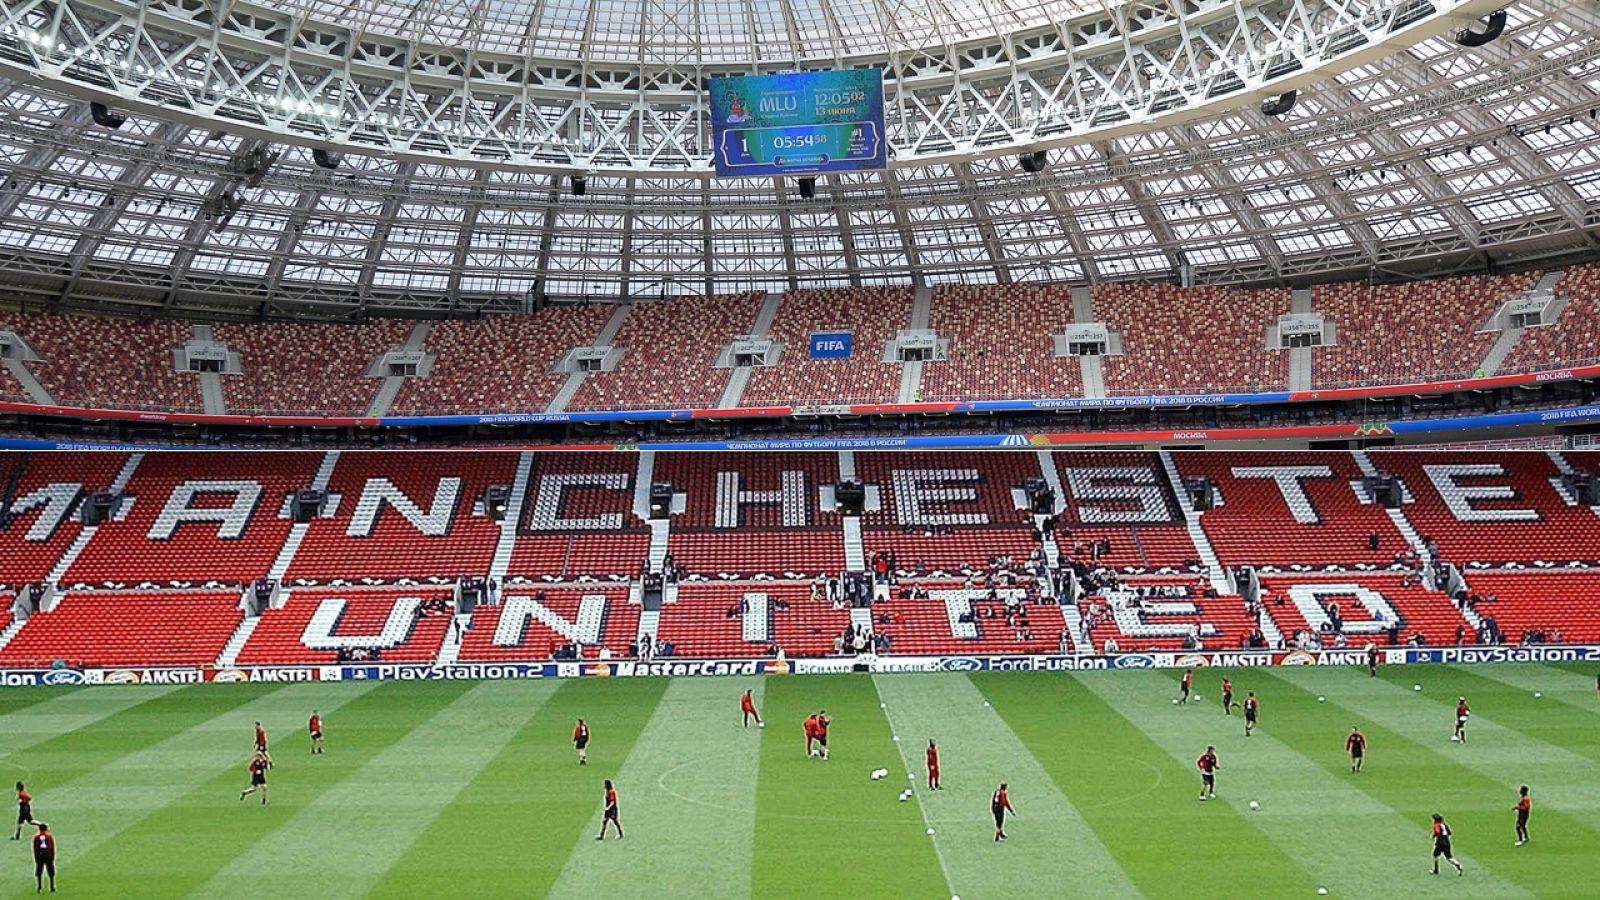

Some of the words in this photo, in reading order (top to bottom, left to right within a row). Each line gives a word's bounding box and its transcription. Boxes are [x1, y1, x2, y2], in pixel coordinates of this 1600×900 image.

[760, 96, 797, 112] MLU
[740, 138, 748, 152] 1
[816, 341, 845, 351] FIFA
[1535, 370, 1574, 381] МОСКВА
[1115, 398, 1150, 406] ФУТБОЛУ
[1193, 396, 1225, 404] РОССИИ
[1540, 412, 1560, 421] 2018
[1560, 410, 1578, 418] FIFA
[1173, 431, 1207, 440] МОСКВА
[803, 440, 836, 448] ФУТБОЛУ
[616, 661, 757, 677] MasterCard
